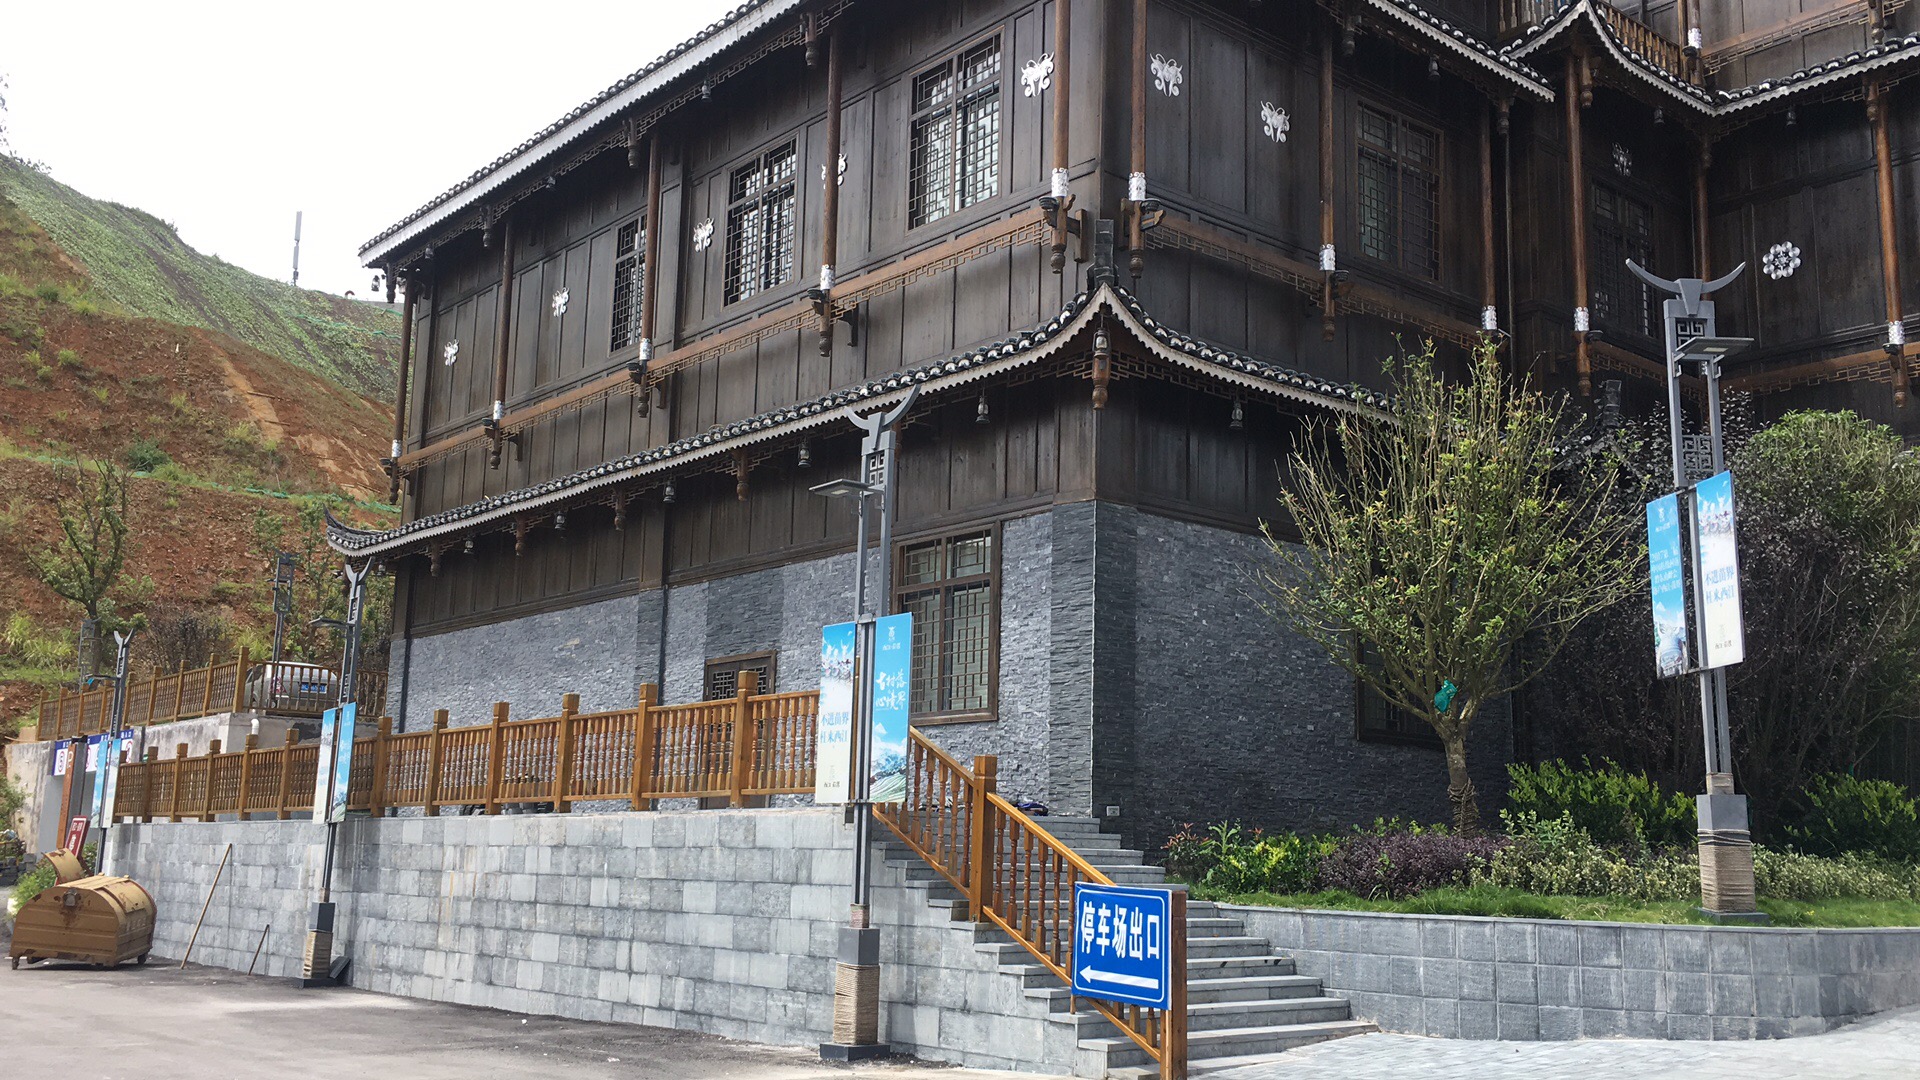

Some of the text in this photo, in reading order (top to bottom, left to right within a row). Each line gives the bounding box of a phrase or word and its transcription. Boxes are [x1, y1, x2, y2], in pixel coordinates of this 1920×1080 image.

[1082, 901, 1159, 960] 停车场出口
